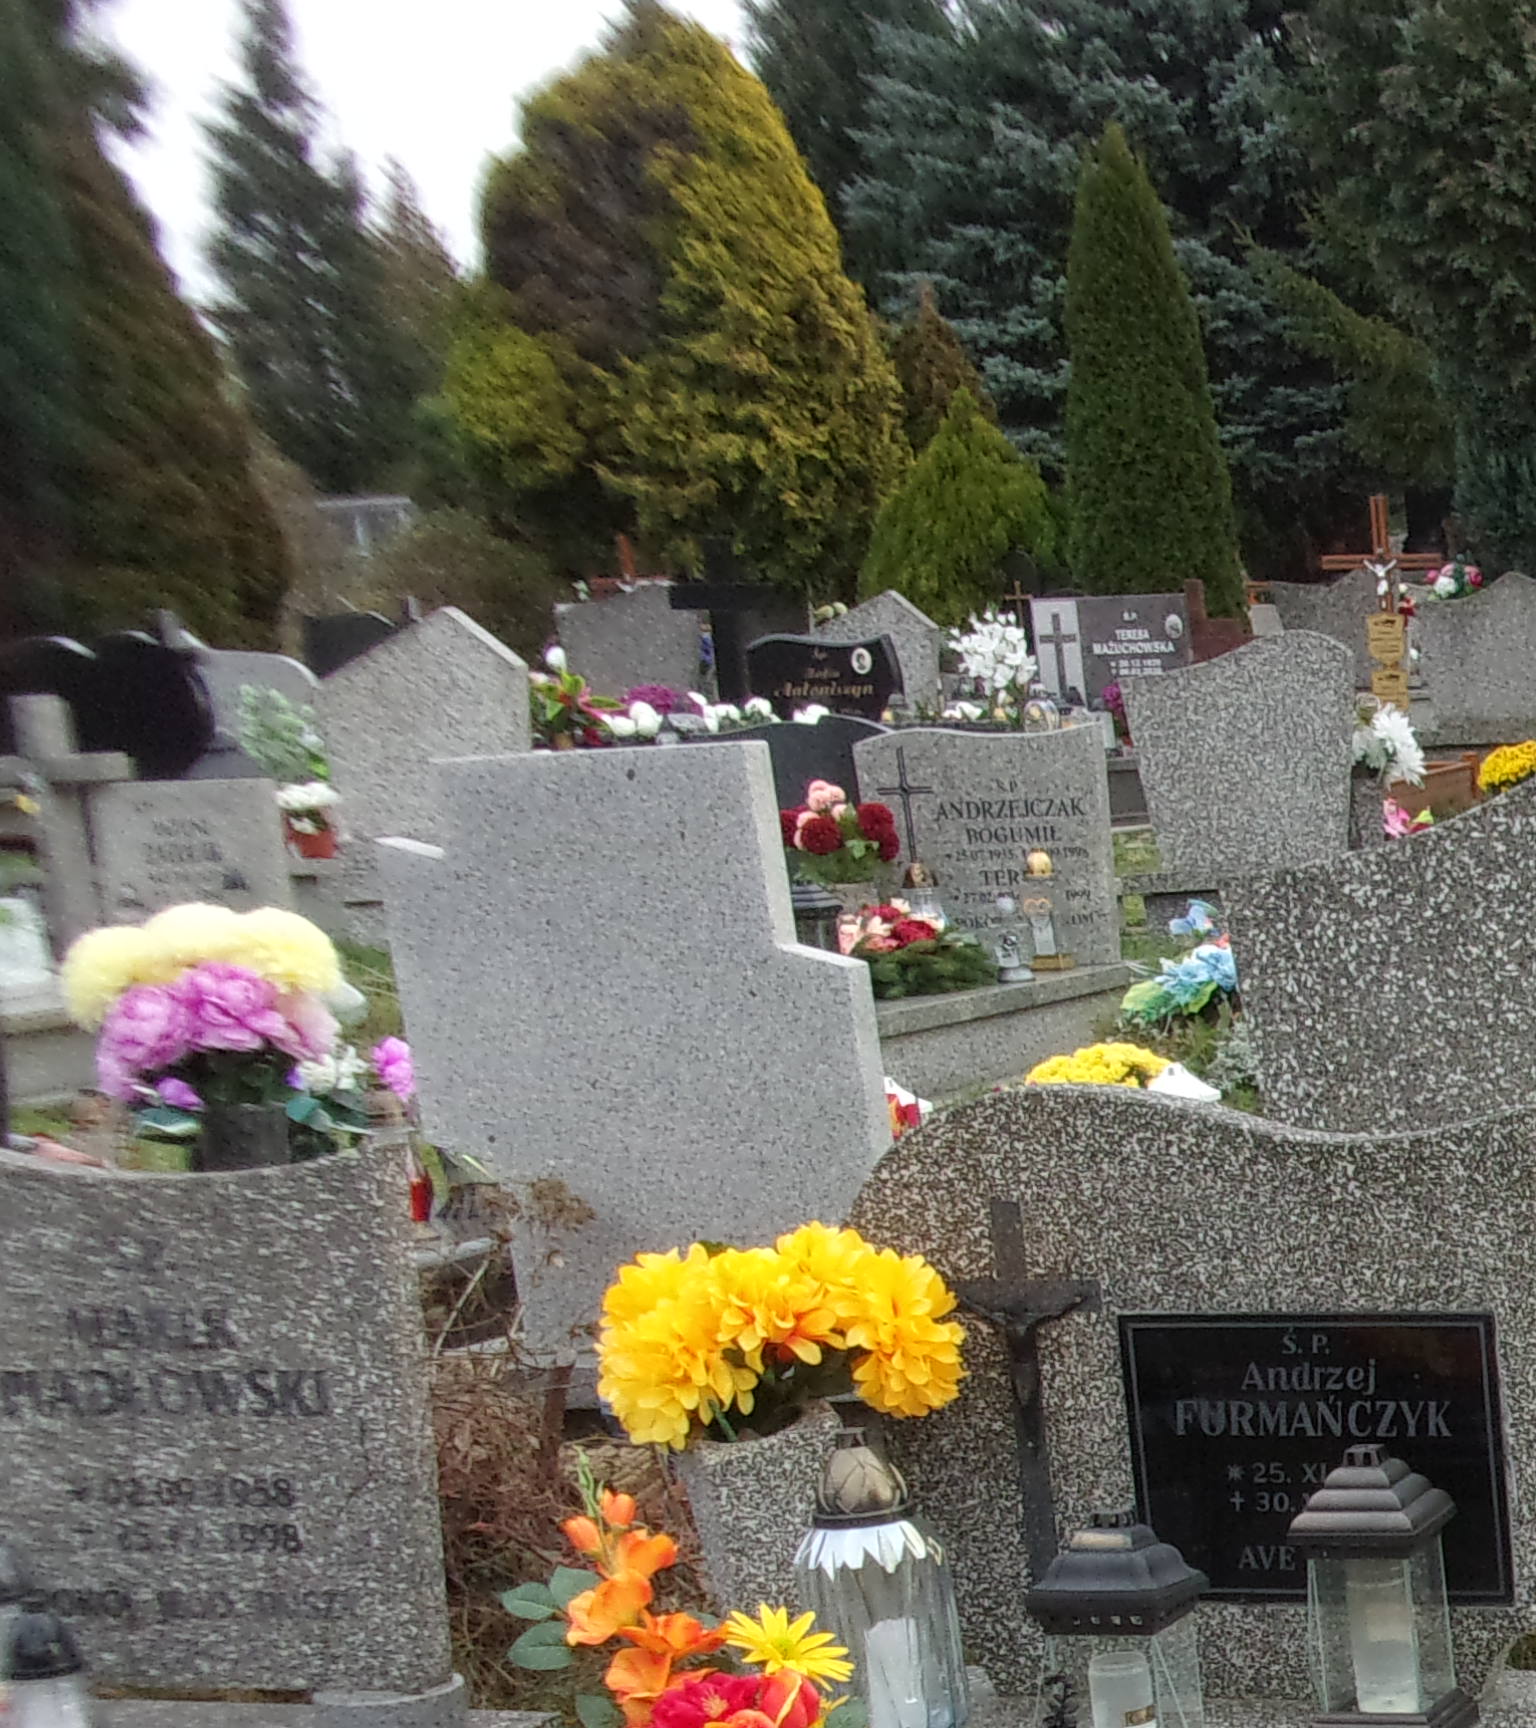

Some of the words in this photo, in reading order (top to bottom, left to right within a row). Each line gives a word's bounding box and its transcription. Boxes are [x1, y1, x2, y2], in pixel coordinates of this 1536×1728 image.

[1114, 629, 1150, 641] TERESA
[935, 798, 1086, 822] ANDRZEJCZAK
[965, 825, 1062, 846] BOGUMIŁ
[1311, 1333, 1331, 1355] P.
[1241, 1358, 1377, 1396] Andrzej
[1174, 1395, 1453, 1438] FURMAŃCZYK
[1238, 1546, 1297, 1570] AVE
